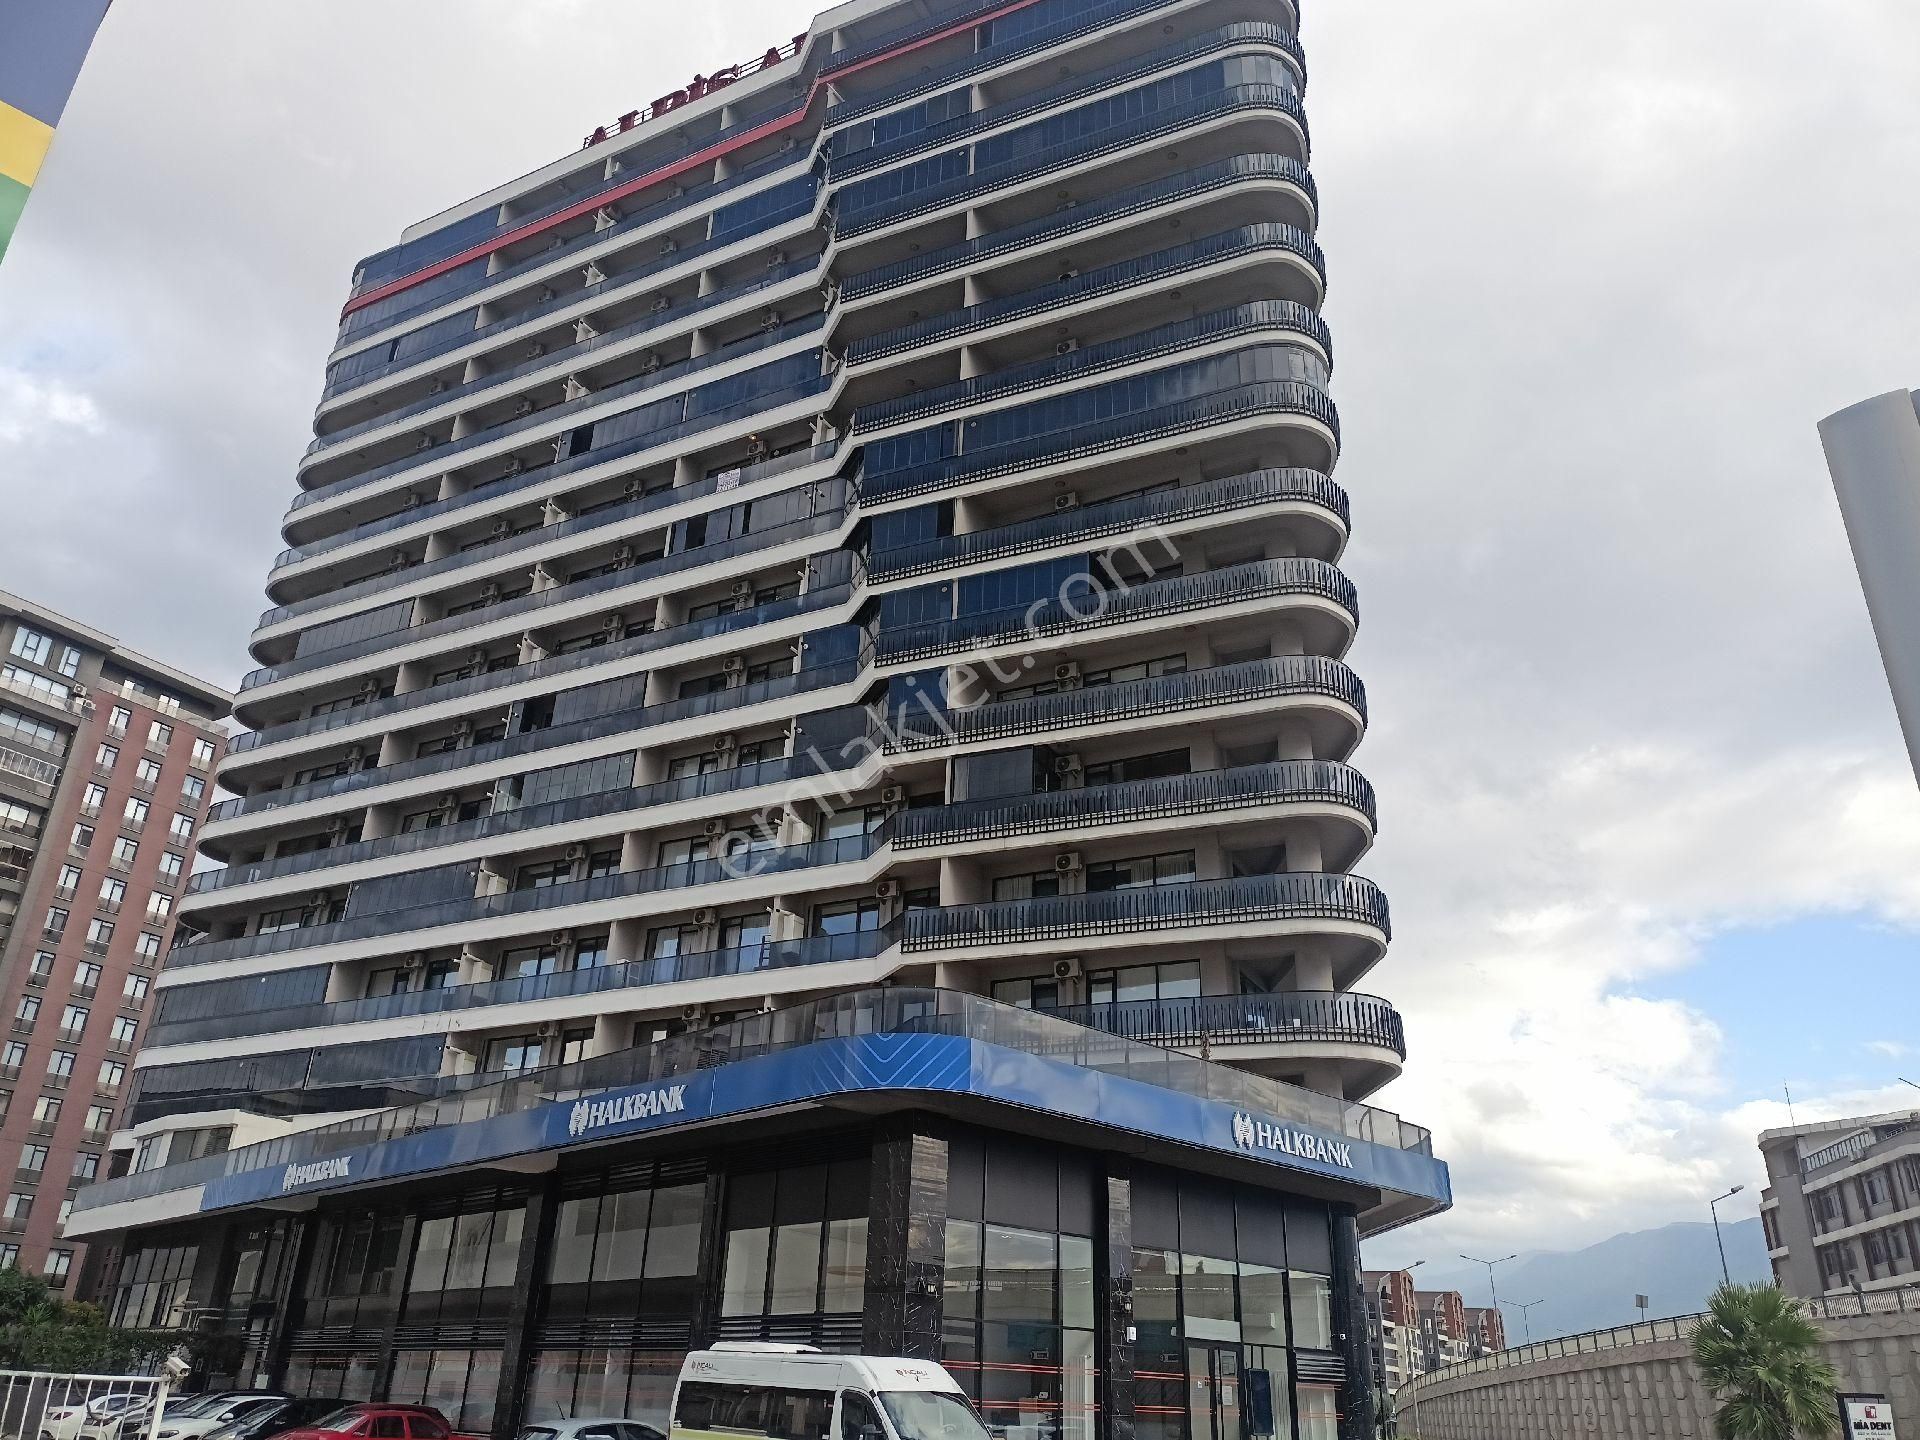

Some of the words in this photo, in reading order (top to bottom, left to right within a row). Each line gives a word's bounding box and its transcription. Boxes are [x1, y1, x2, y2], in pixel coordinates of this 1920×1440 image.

[588, 1085, 688, 1128] HALKBANK
[1256, 1122, 1353, 1168] HALKBANK
[294, 1156, 352, 1185] HALKBANK
[1870, 1422, 1891, 1430] DENT
